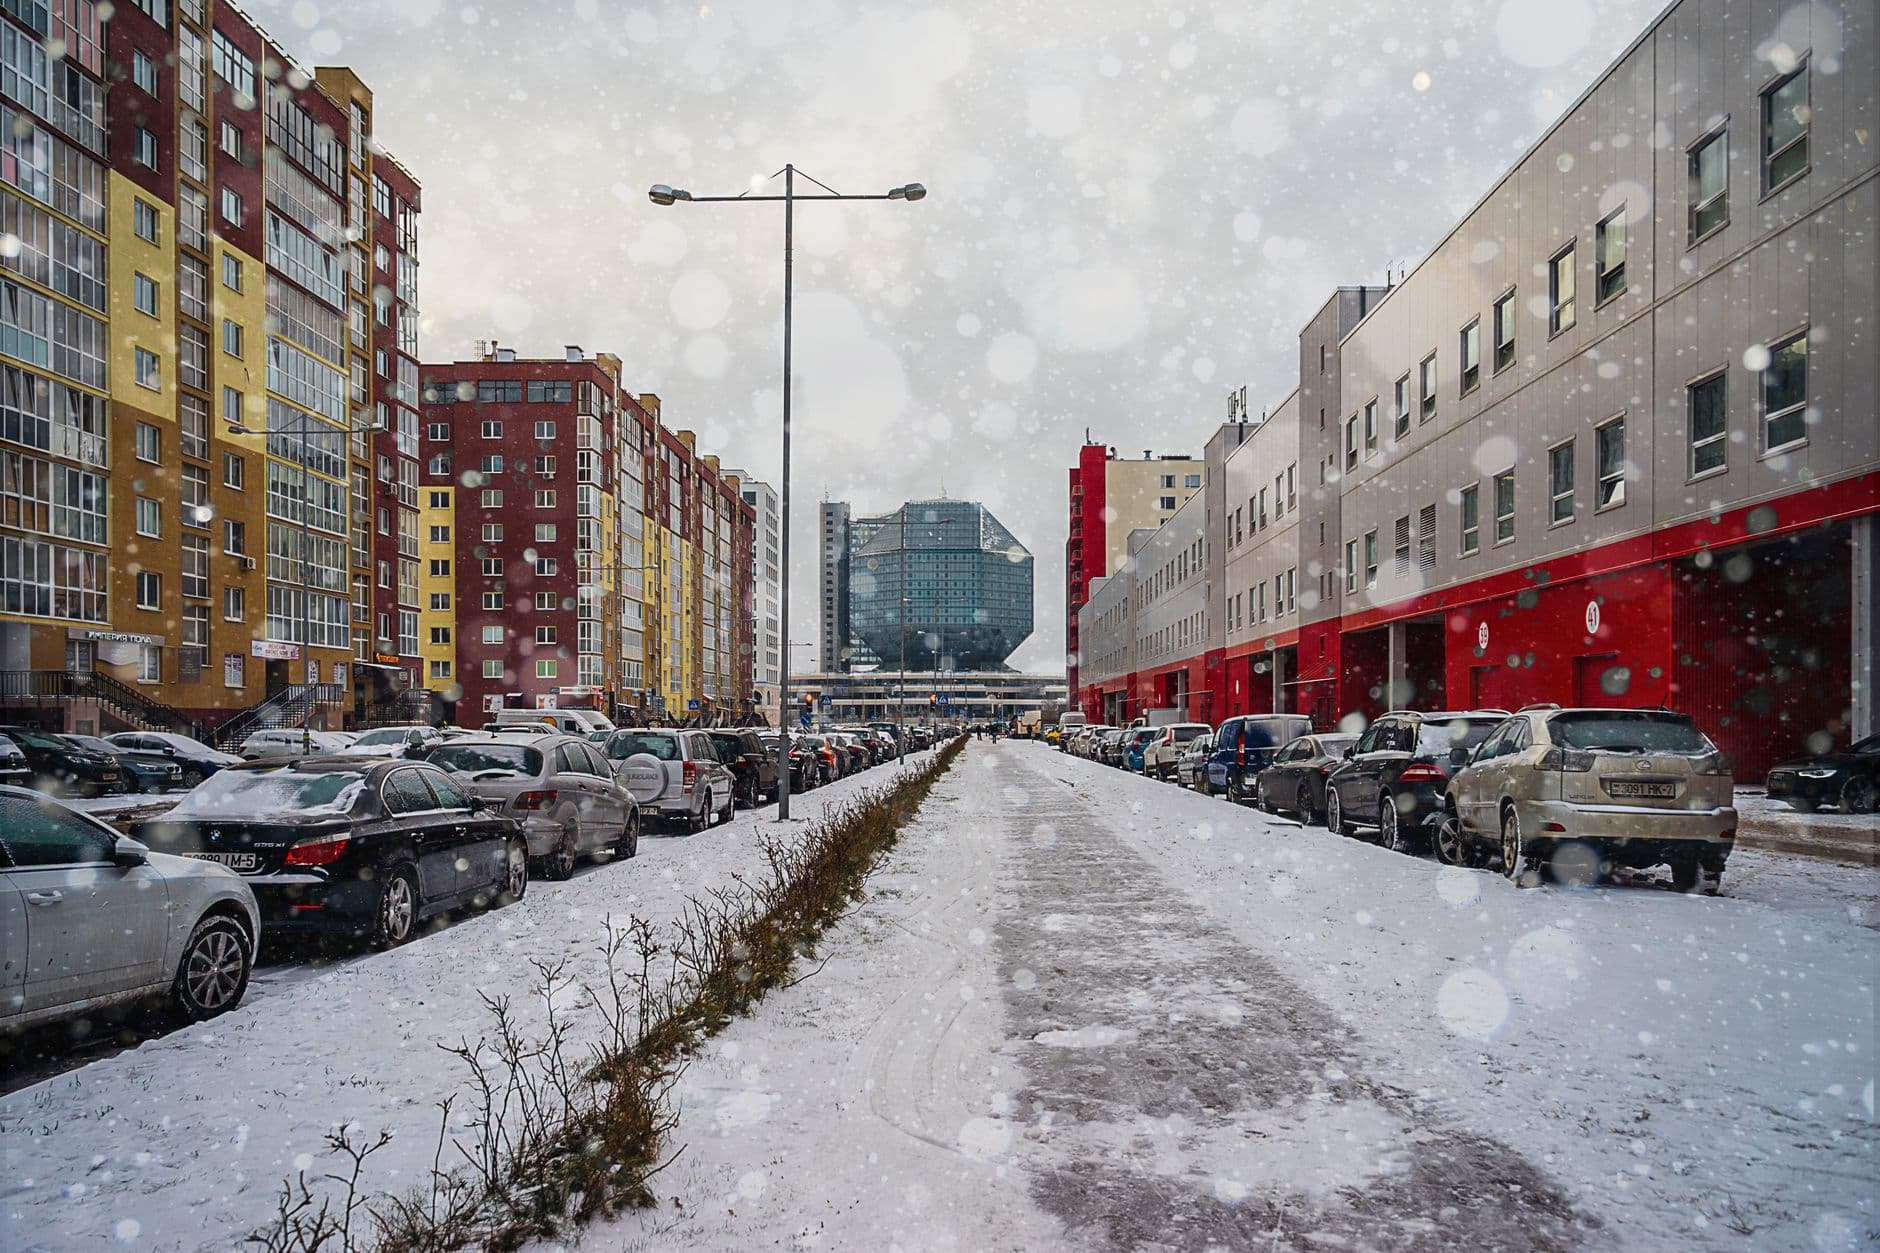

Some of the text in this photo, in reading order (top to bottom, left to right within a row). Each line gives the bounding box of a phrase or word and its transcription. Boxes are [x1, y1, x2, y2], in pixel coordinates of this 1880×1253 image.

[1588, 607, 1597, 627] 41
[88, 631, 152, 644] ИМПЕРИЯ ПОЛА
[1480, 627, 1488, 644] 39
